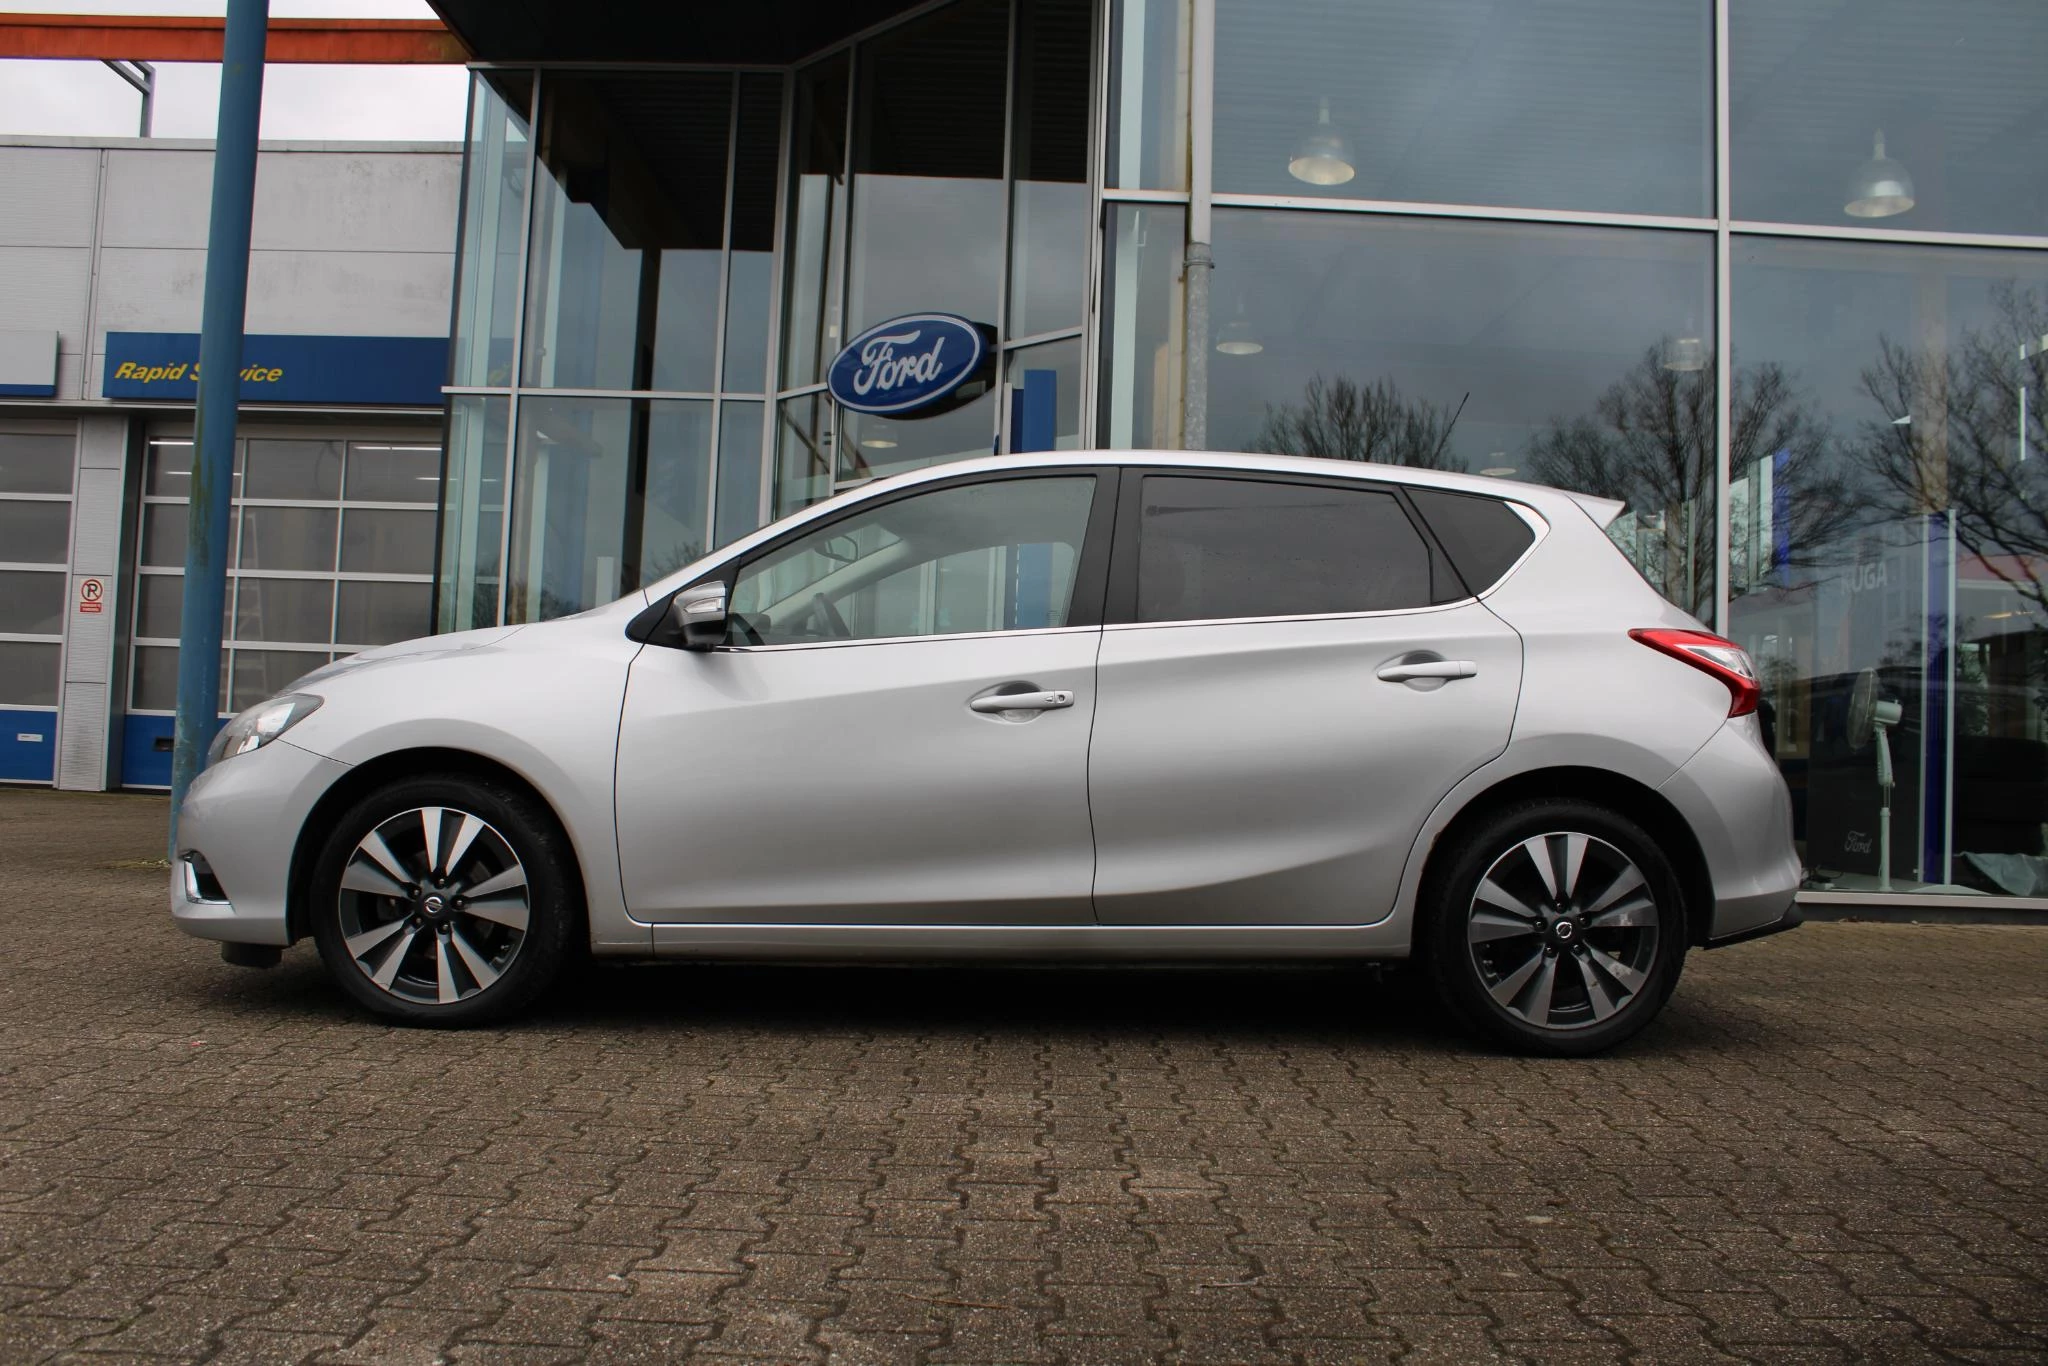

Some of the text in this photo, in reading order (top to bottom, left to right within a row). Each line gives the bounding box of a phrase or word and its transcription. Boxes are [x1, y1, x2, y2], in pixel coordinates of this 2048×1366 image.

[114, 361, 283, 383] Rapid Sice
[853, 330, 945, 396] Ford
[1844, 830, 1873, 854] Ford
